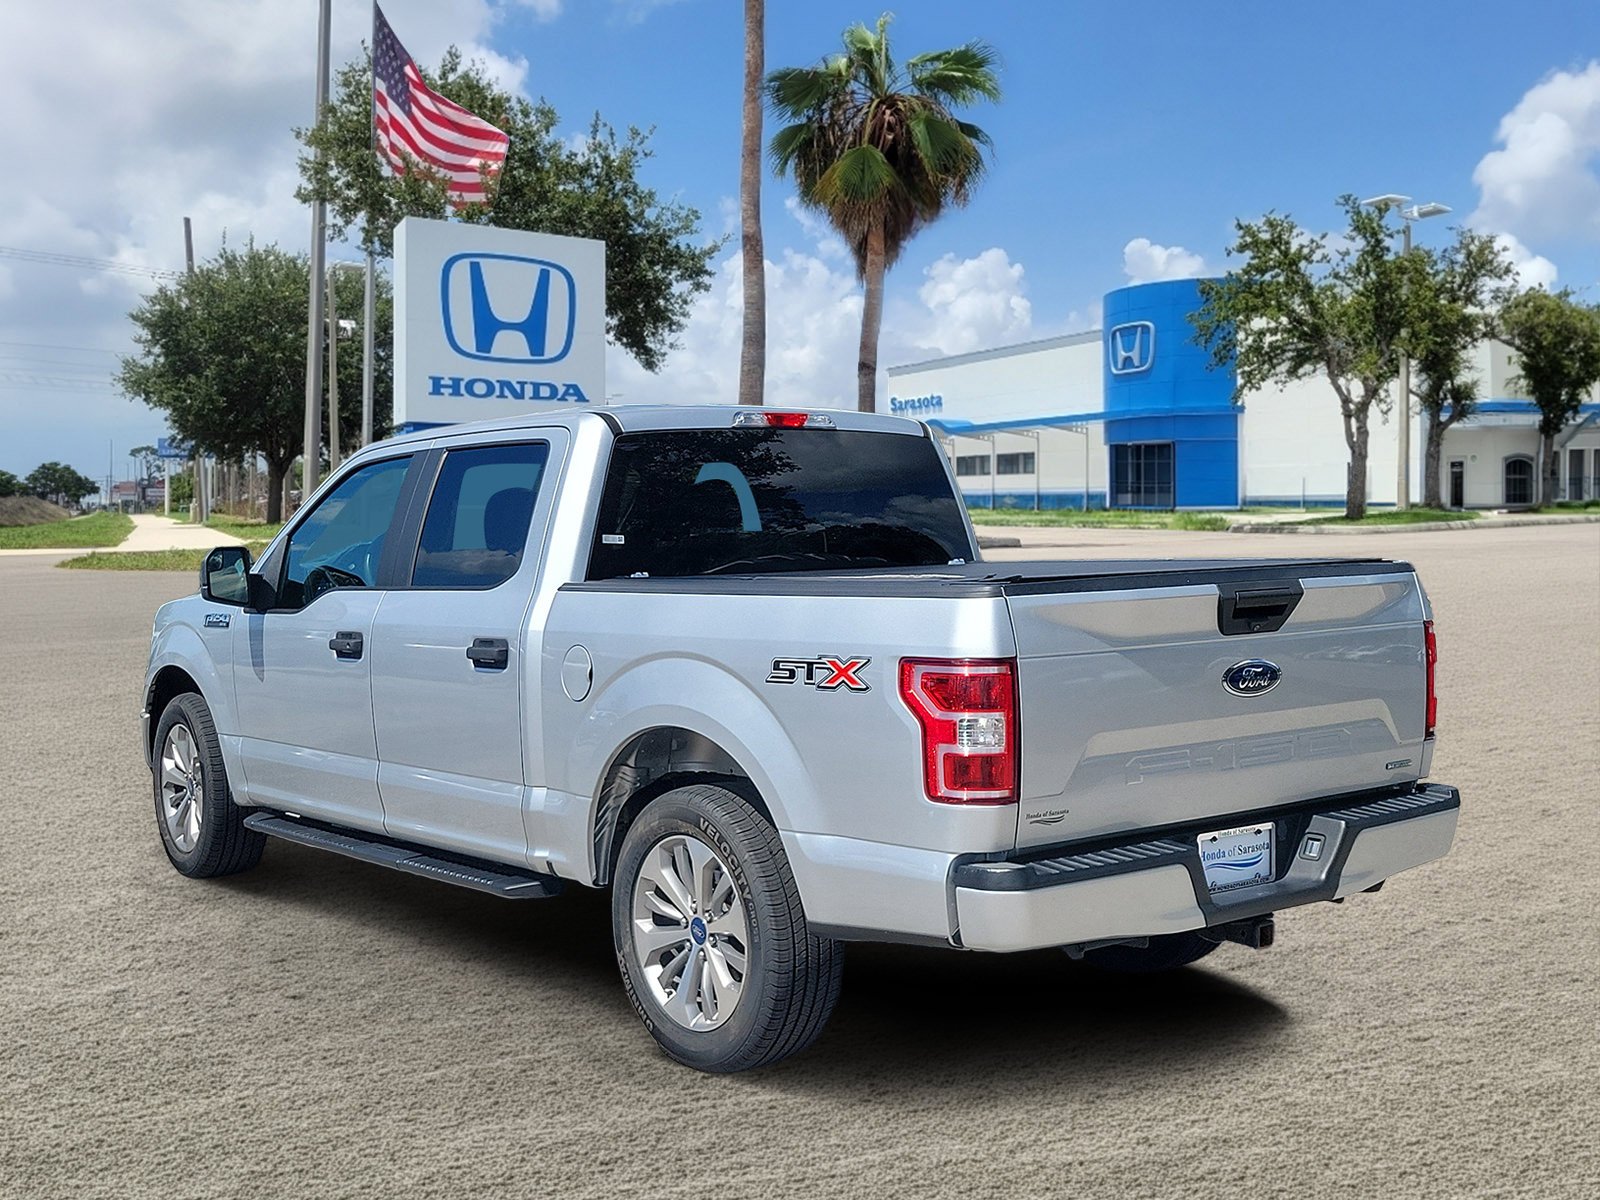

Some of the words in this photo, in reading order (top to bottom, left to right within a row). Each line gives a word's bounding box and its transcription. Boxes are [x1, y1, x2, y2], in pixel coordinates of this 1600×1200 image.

[428, 376, 590, 403] HONDA
[890, 394, 943, 411] Sarasota
[764, 654, 873, 694] STX
[1237, 667, 1273, 690] Ford
[700, 817, 753, 904] VELOCITY
[1228, 845, 1237, 858] of
[1237, 840, 1270, 856] Sarasota
